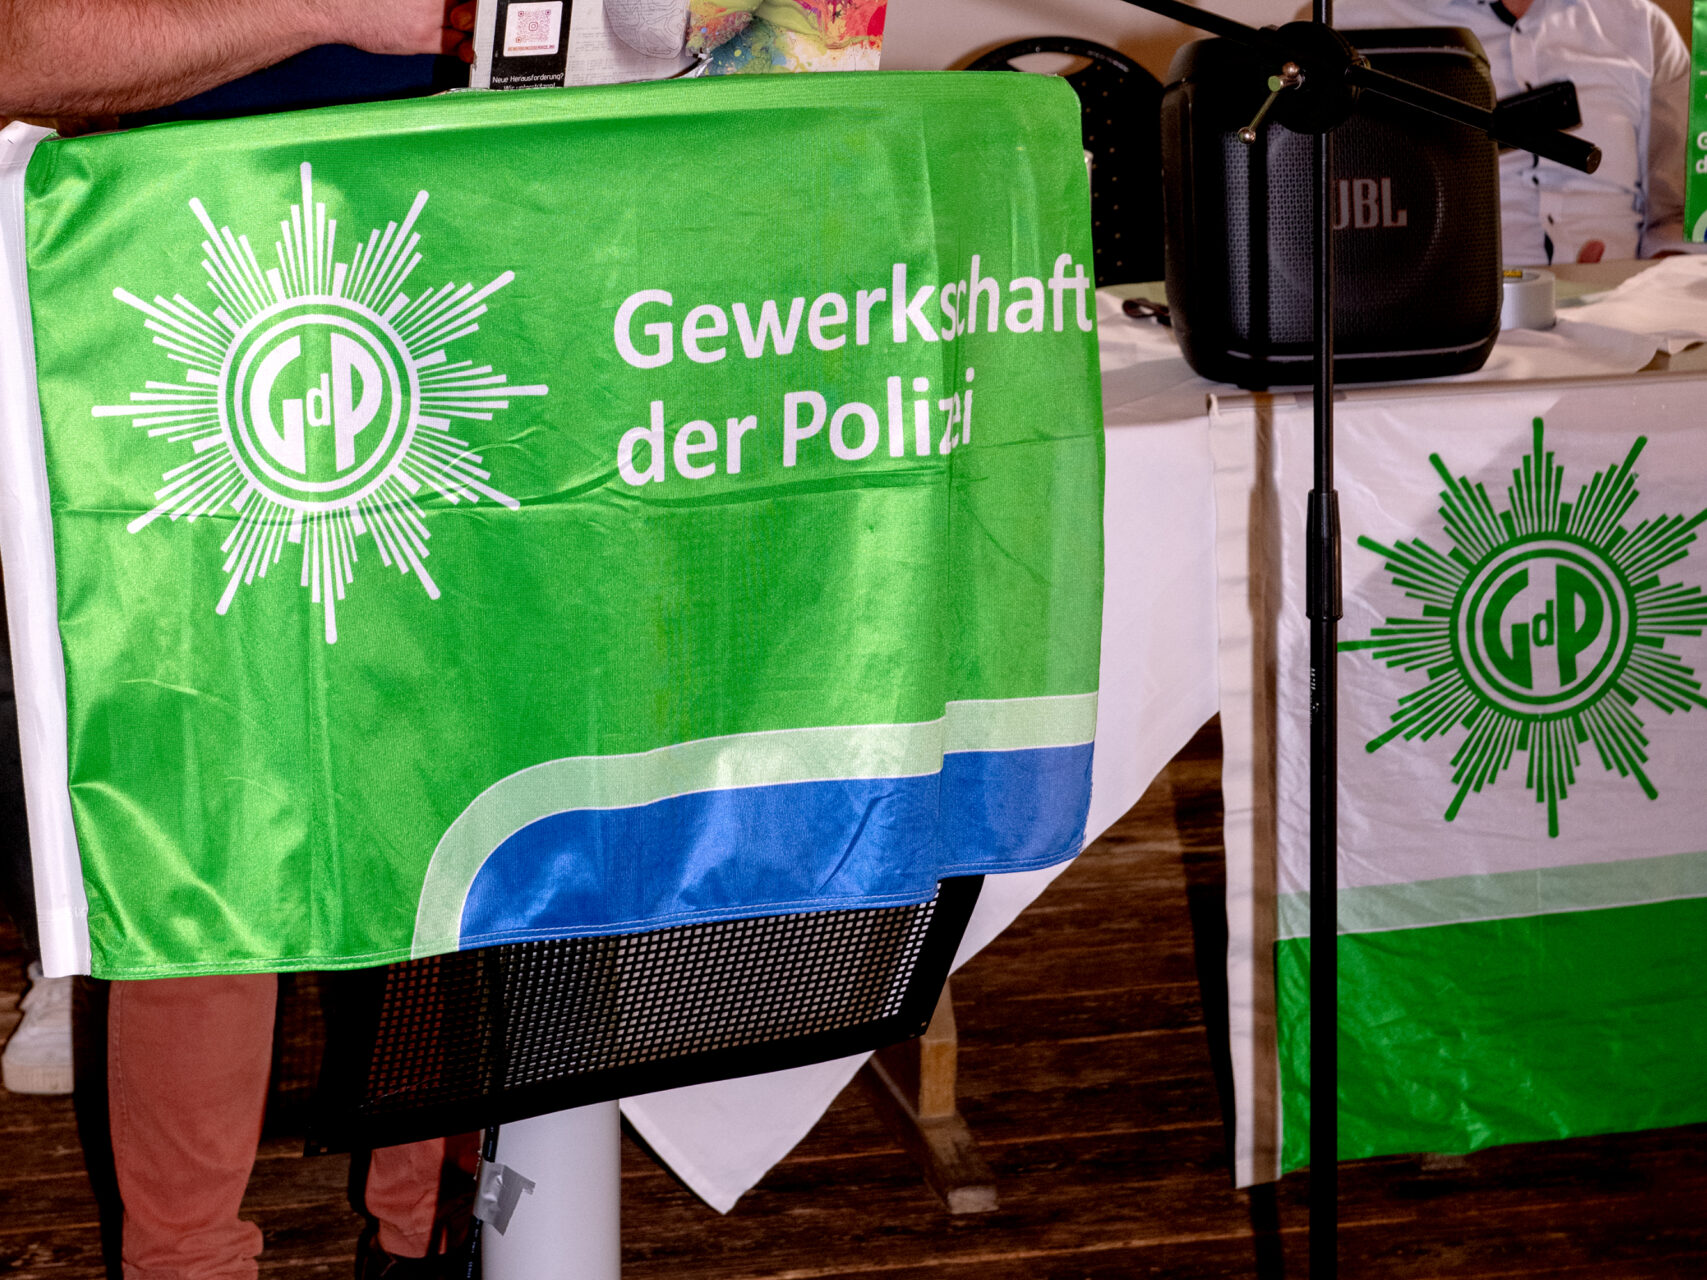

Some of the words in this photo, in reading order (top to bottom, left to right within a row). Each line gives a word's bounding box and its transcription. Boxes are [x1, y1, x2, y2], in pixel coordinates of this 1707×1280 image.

[1333, 177, 1408, 229] JBL
[613, 253, 1092, 370] Gewerkschaft
[250, 333, 384, 476] GdP
[616, 400, 758, 486] der
[783, 367, 975, 466] Polizei
[1482, 564, 1604, 690] GdP
